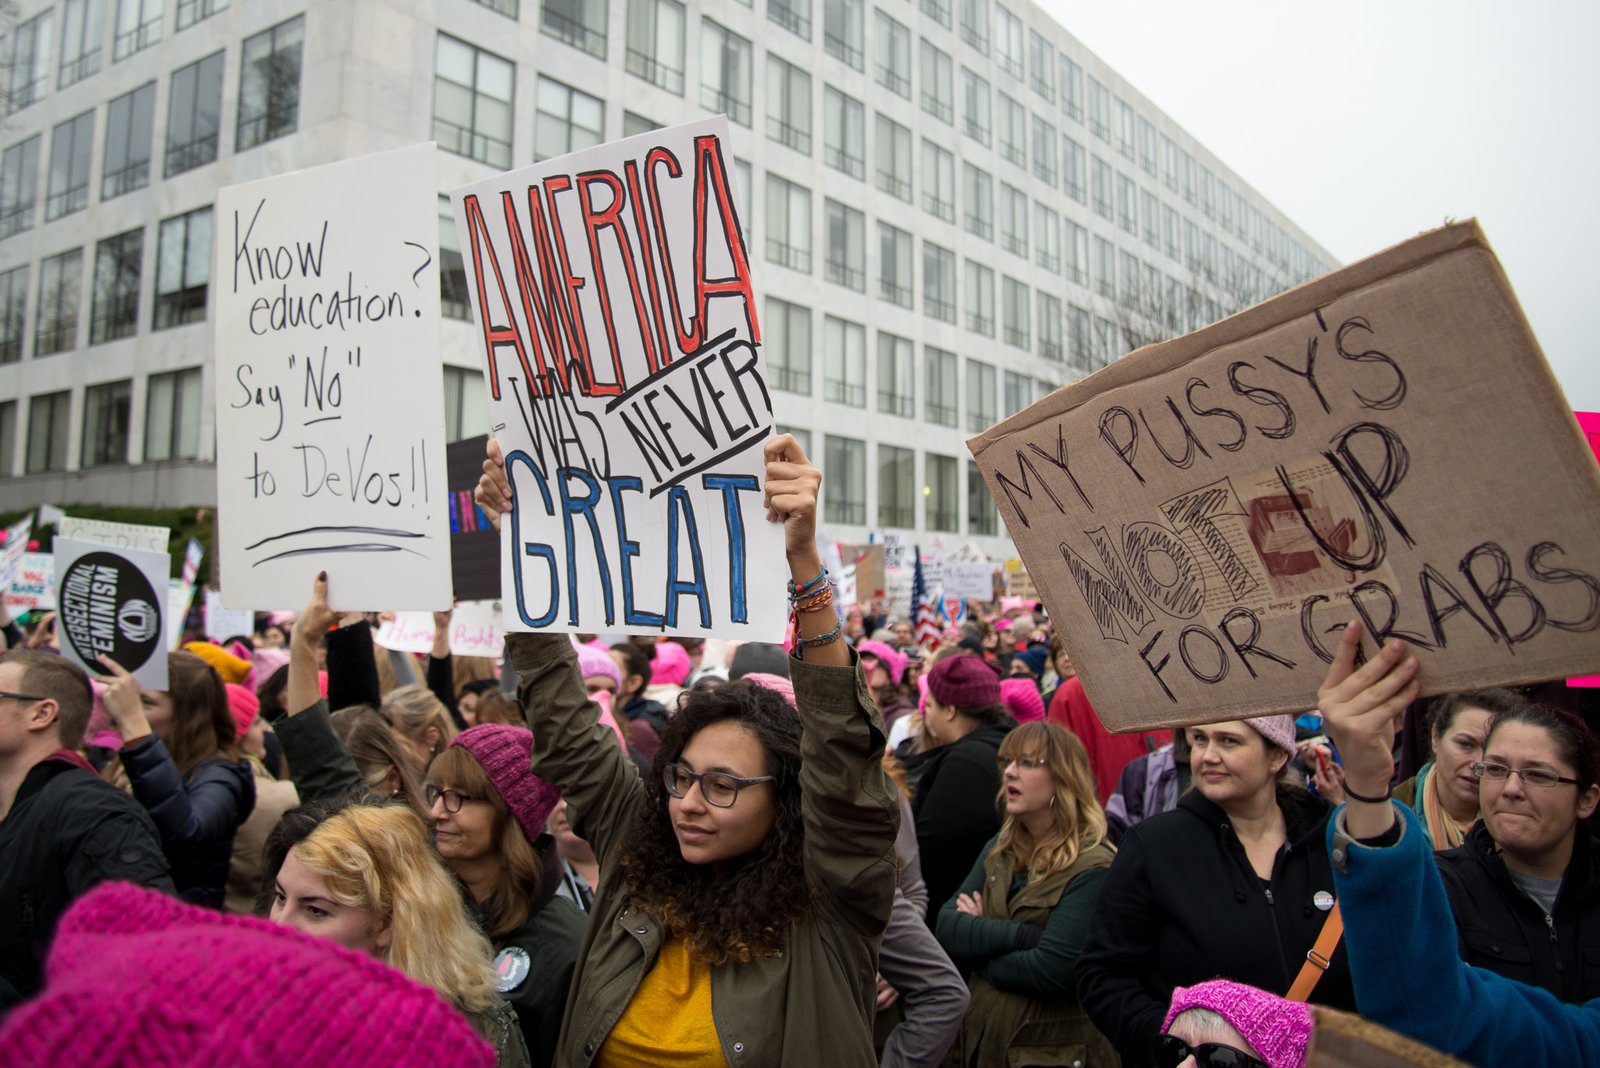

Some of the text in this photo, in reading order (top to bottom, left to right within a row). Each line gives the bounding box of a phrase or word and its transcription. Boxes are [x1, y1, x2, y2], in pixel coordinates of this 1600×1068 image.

[234, 198, 328, 294] Know
[249, 241, 432, 336] education?
[464, 134, 761, 400] AMERICA
[230, 363, 284, 442] Say
[508, 340, 775, 483] WAS NEVER
[994, 306, 1407, 529] MY PUSSY'S
[244, 433, 431, 521] to DeVos!!
[504, 449, 761, 632] GREAT
[1058, 476, 1260, 645] NOT
[1274, 421, 1418, 574] UP
[63, 563, 97, 660] INTERSECTIONAL
[1138, 606, 1296, 704] FOR
[1300, 541, 1600, 666] GRABS
